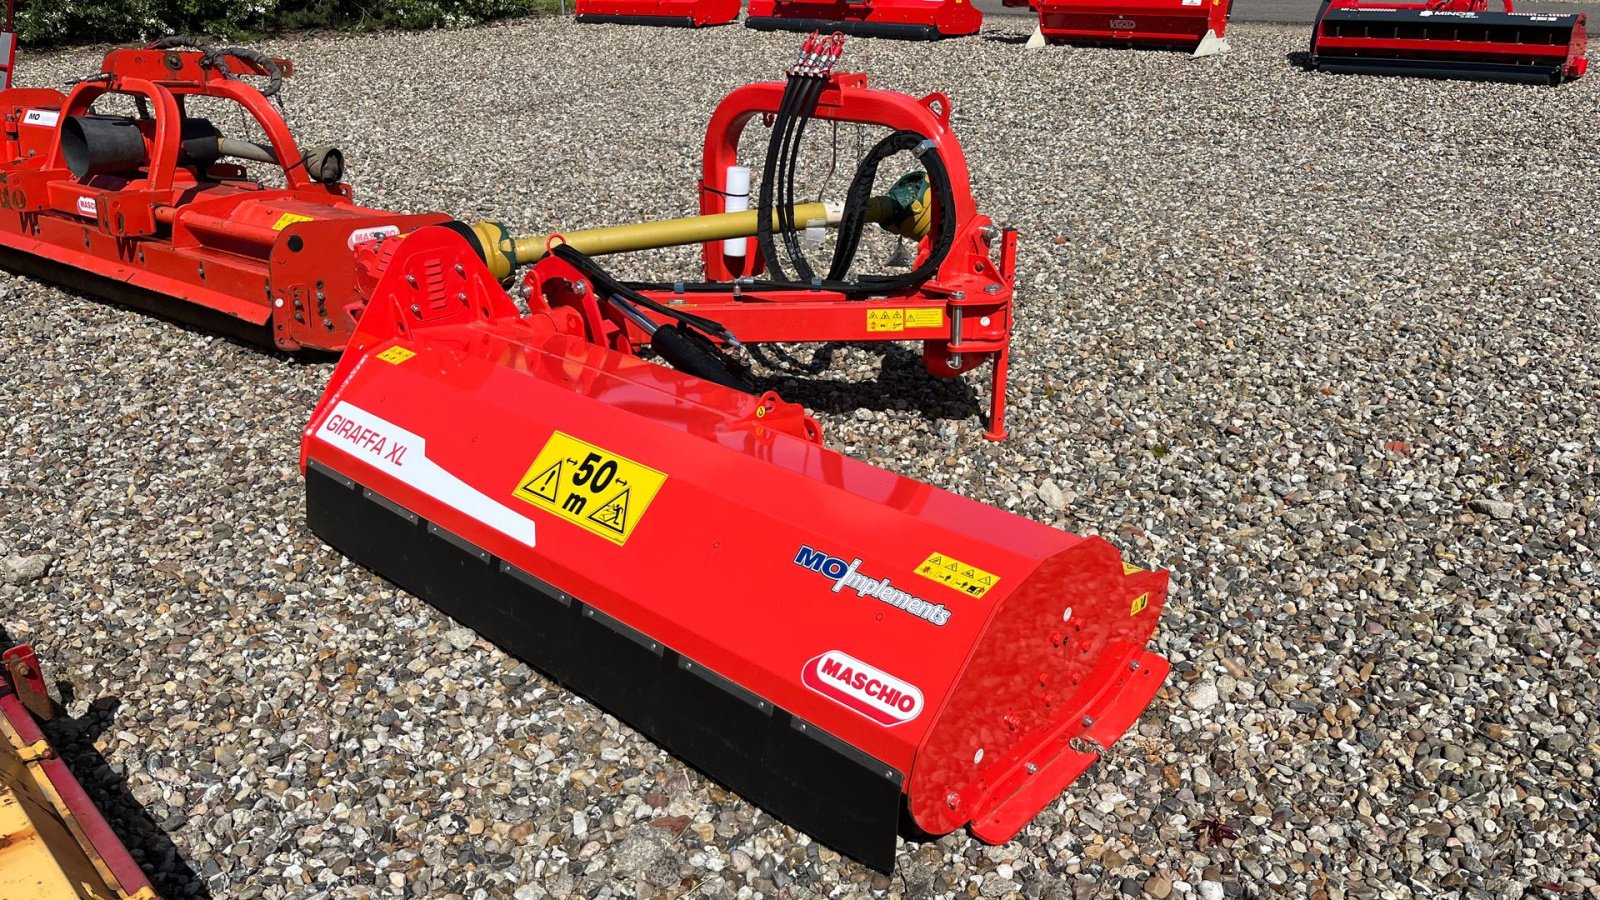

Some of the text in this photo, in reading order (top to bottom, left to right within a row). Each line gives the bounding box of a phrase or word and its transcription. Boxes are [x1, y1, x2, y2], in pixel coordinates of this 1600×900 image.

[326, 414, 407, 466] GIRAFFA XL
[572, 452, 617, 493] 50
[562, 493, 587, 515] m
[821, 658, 915, 712] MASCHIO
